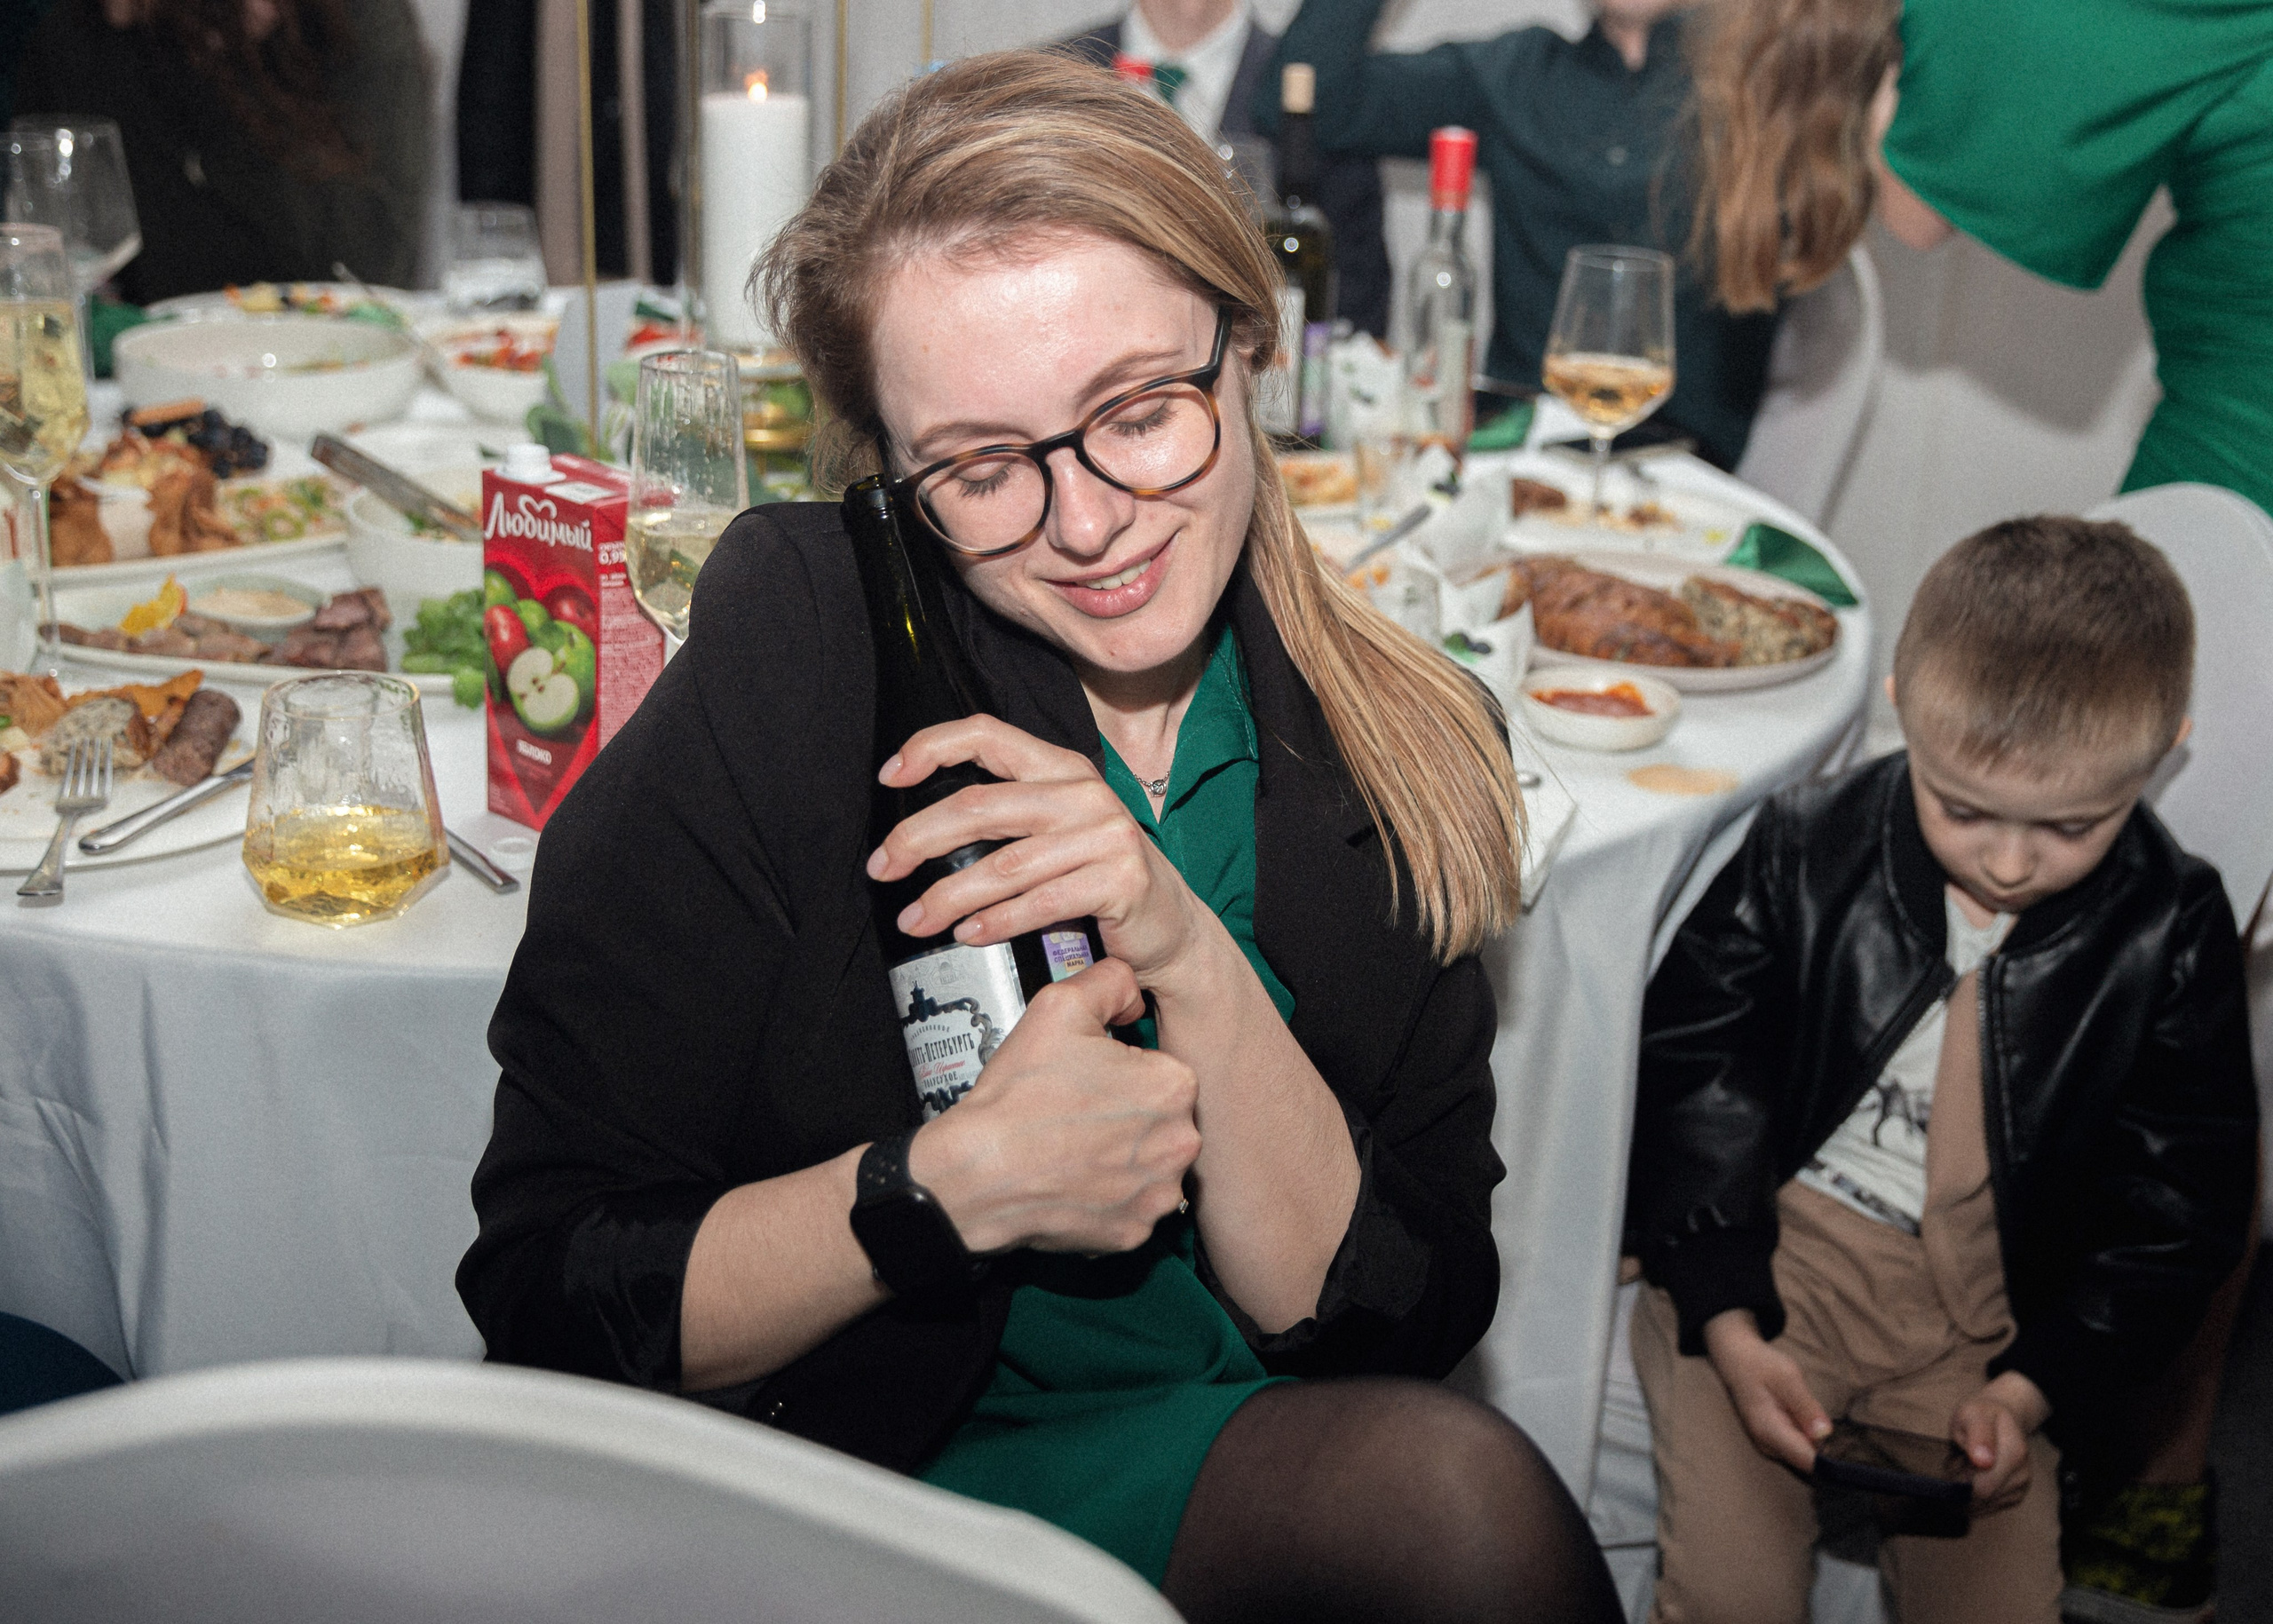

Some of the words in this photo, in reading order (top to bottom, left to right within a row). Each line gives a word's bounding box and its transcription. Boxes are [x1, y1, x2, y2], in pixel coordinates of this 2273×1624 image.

[484, 491, 593, 552] Любимый
[1052, 945, 1088, 956] ФЕДЕРАЛЬНАЯ
[1054, 951, 1089, 963] СПЕЦИАЛЬНАЯ
[1066, 959, 1084, 968] МАРКА
